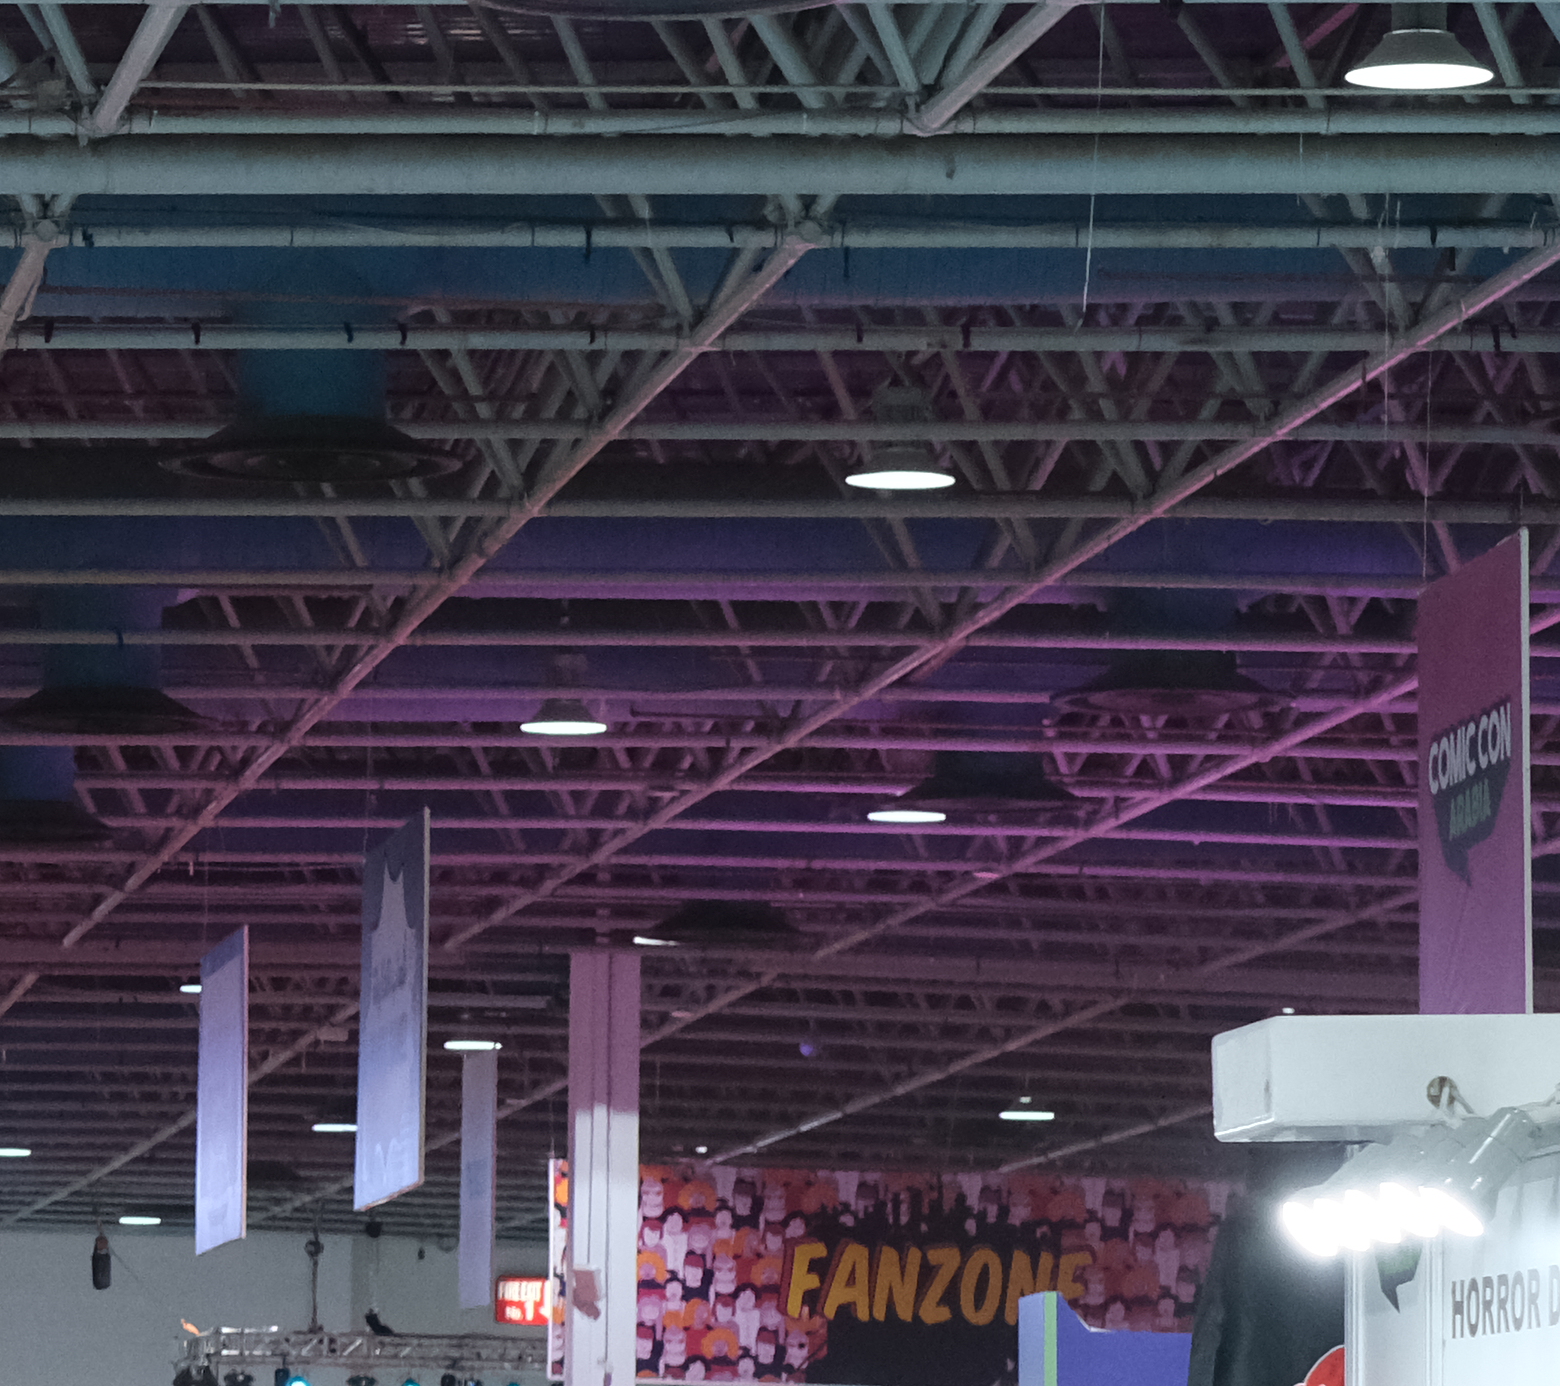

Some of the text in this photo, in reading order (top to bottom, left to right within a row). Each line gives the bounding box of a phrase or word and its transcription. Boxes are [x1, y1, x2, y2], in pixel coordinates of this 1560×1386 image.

[1428, 701, 1512, 796] COMIC CON
[1451, 1269, 1541, 1340] HORROR
